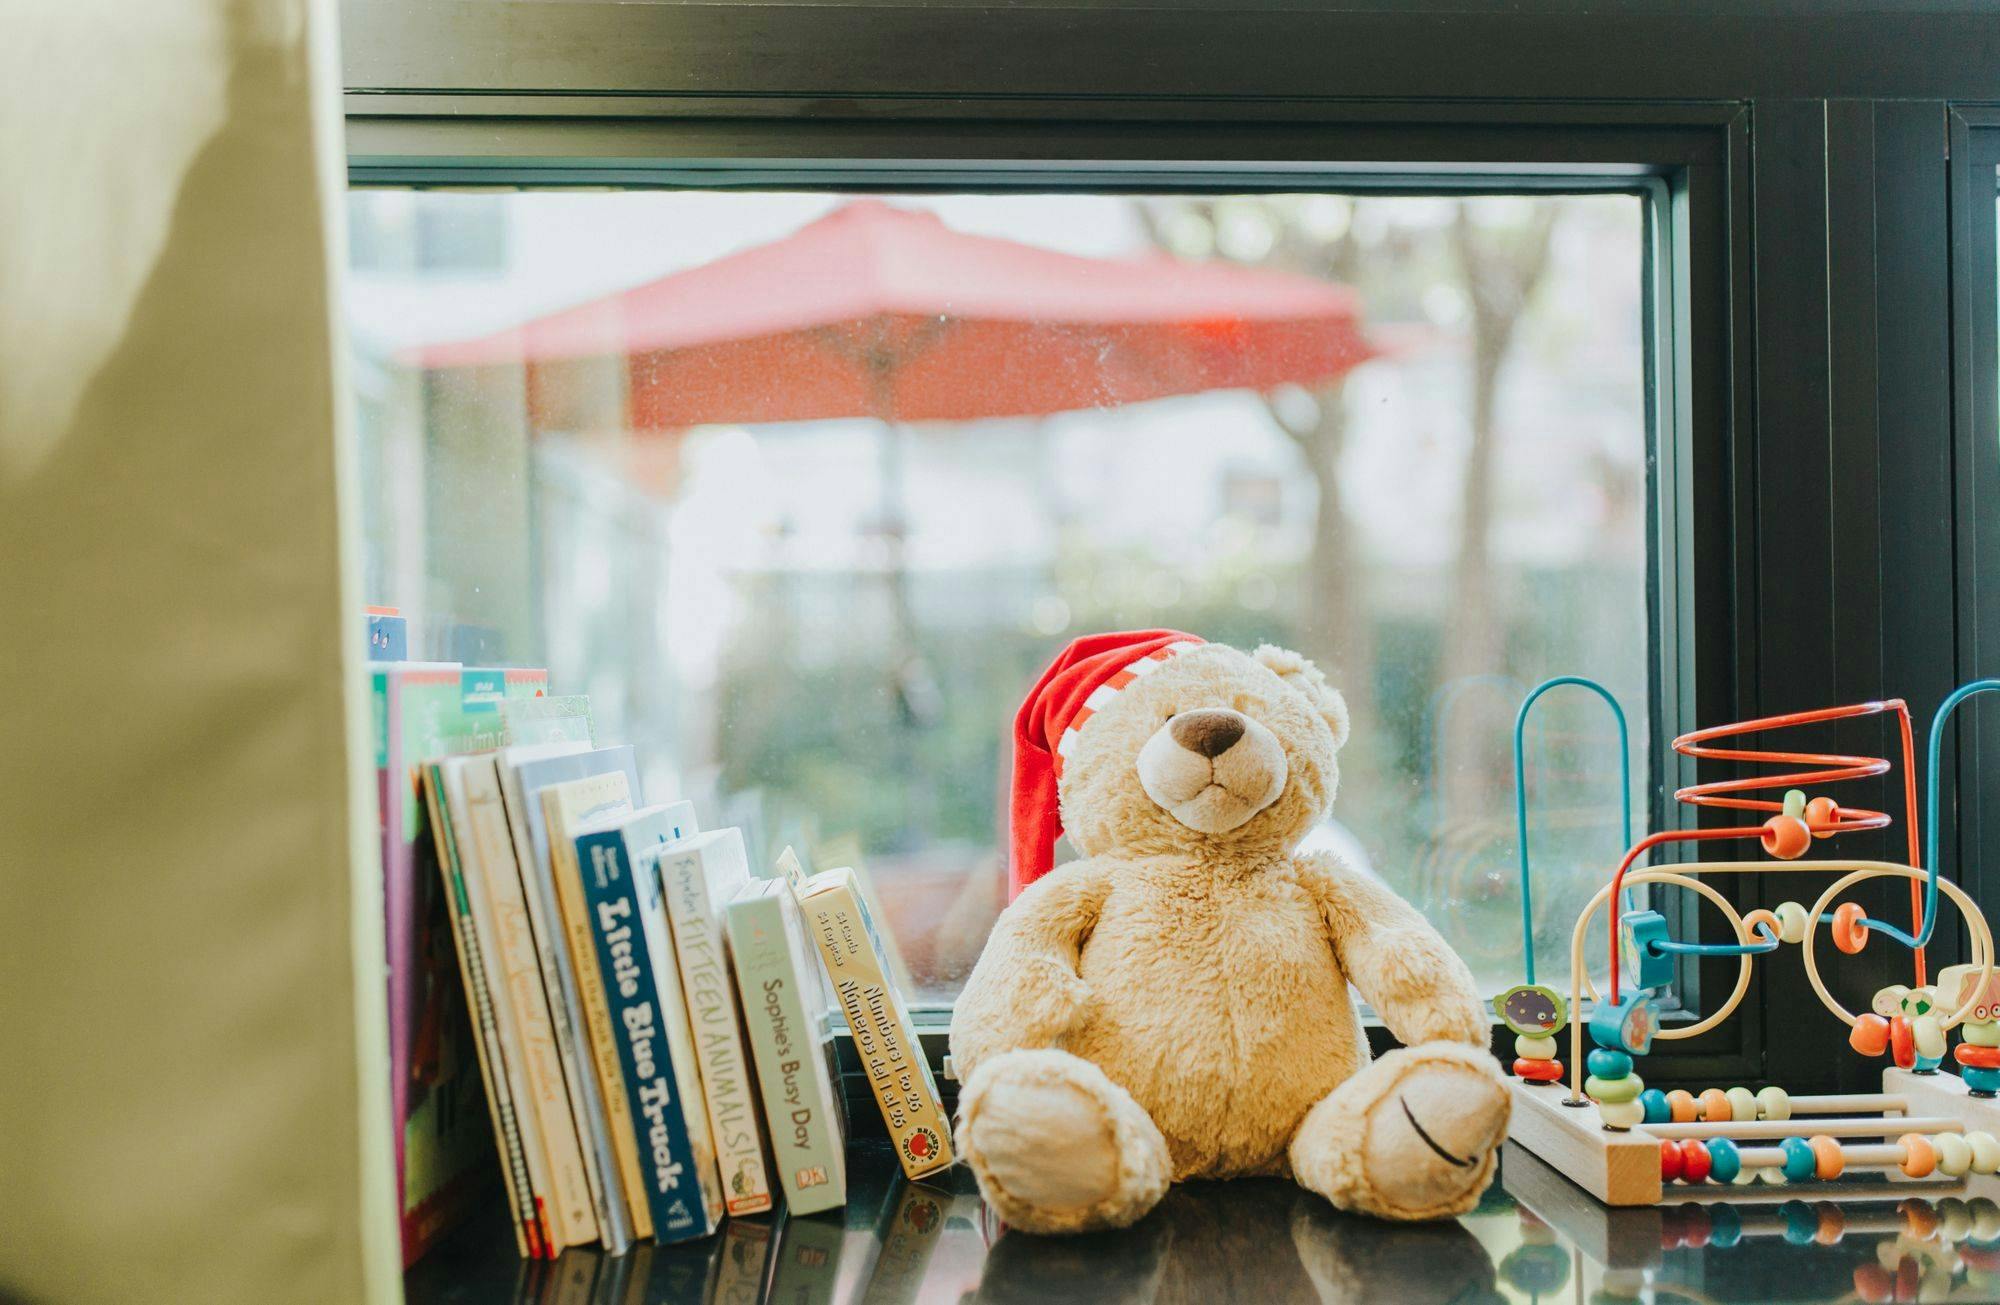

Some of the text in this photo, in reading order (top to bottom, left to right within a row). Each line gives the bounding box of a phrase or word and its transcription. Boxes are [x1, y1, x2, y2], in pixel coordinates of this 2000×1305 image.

[597, 897, 641, 998] Little
[681, 916, 728, 1025] FIFTEEN
[823, 926, 844, 967] Tarjetas
[622, 1001, 656, 1080] Blue
[763, 978, 812, 1150] Sophie's Busy Day
[839, 979, 907, 1129] Números del 1 al 26
[863, 985, 923, 1112] Numbers 1 to 26
[638, 1077, 683, 1194] Truck
[797, 1167, 828, 1190] DK
[917, 1127, 940, 1161] BRIGHTER
